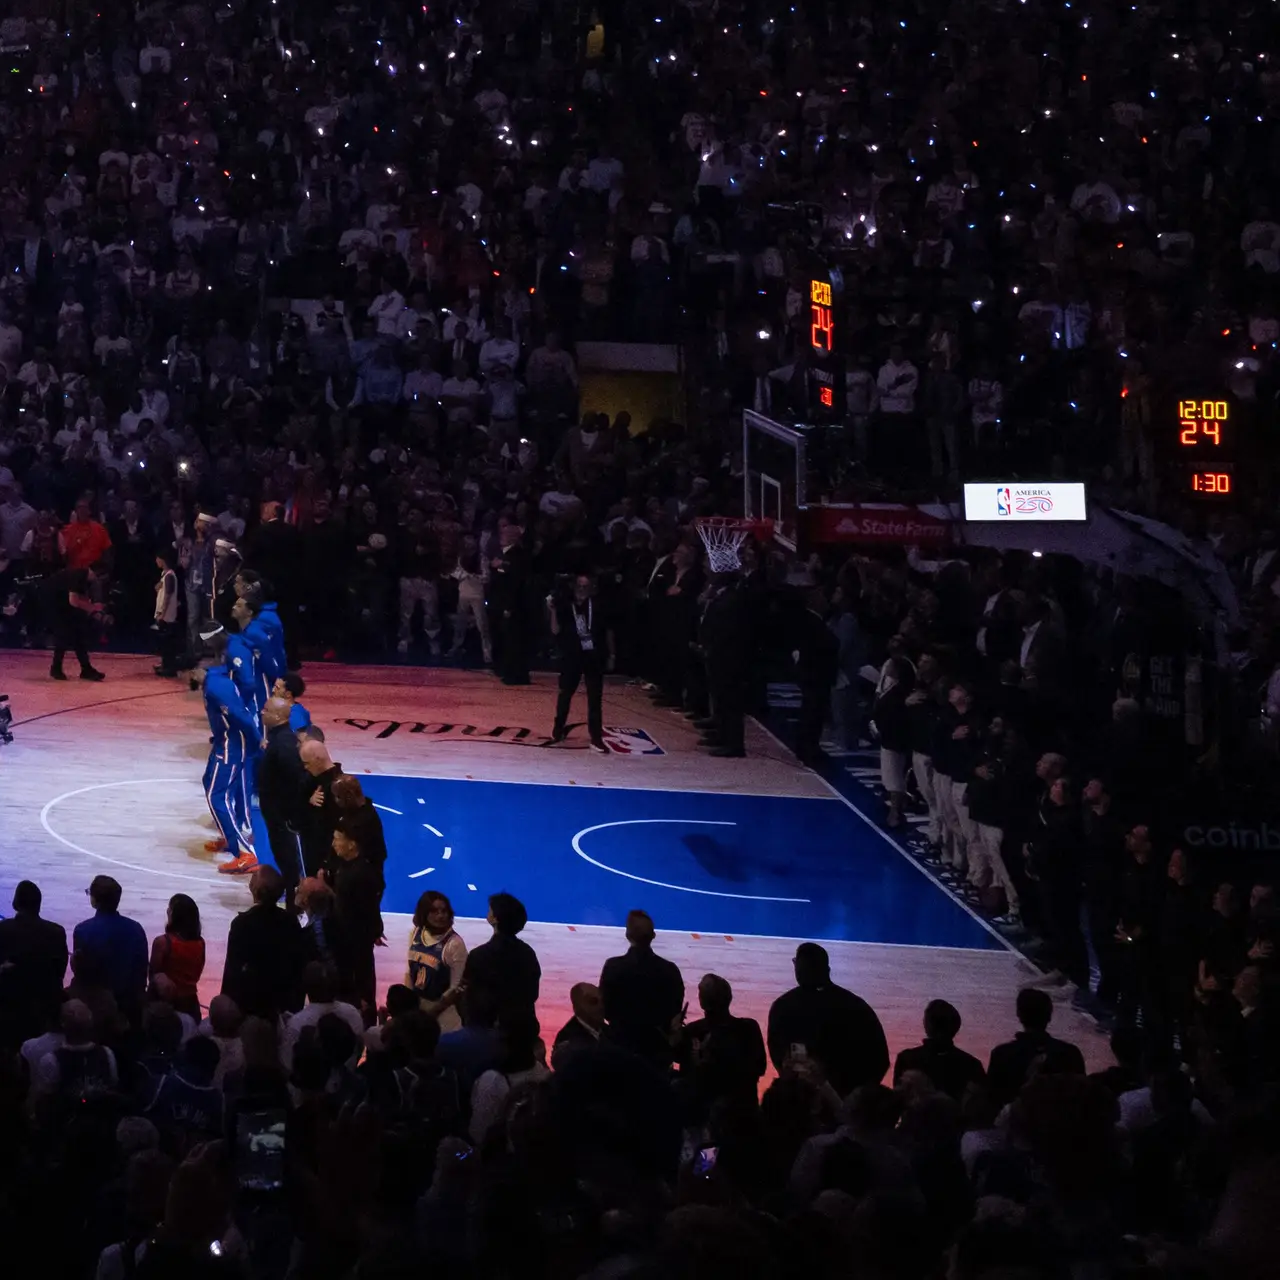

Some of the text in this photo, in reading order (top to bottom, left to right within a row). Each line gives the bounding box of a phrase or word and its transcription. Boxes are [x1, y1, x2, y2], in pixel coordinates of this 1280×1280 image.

[811, 305, 834, 351] 24
[1179, 400, 1228, 420] 12:00
[1180, 421, 1220, 445] 24
[1193, 473, 1230, 493] 1:30
[1015, 496, 1053, 513] 250
